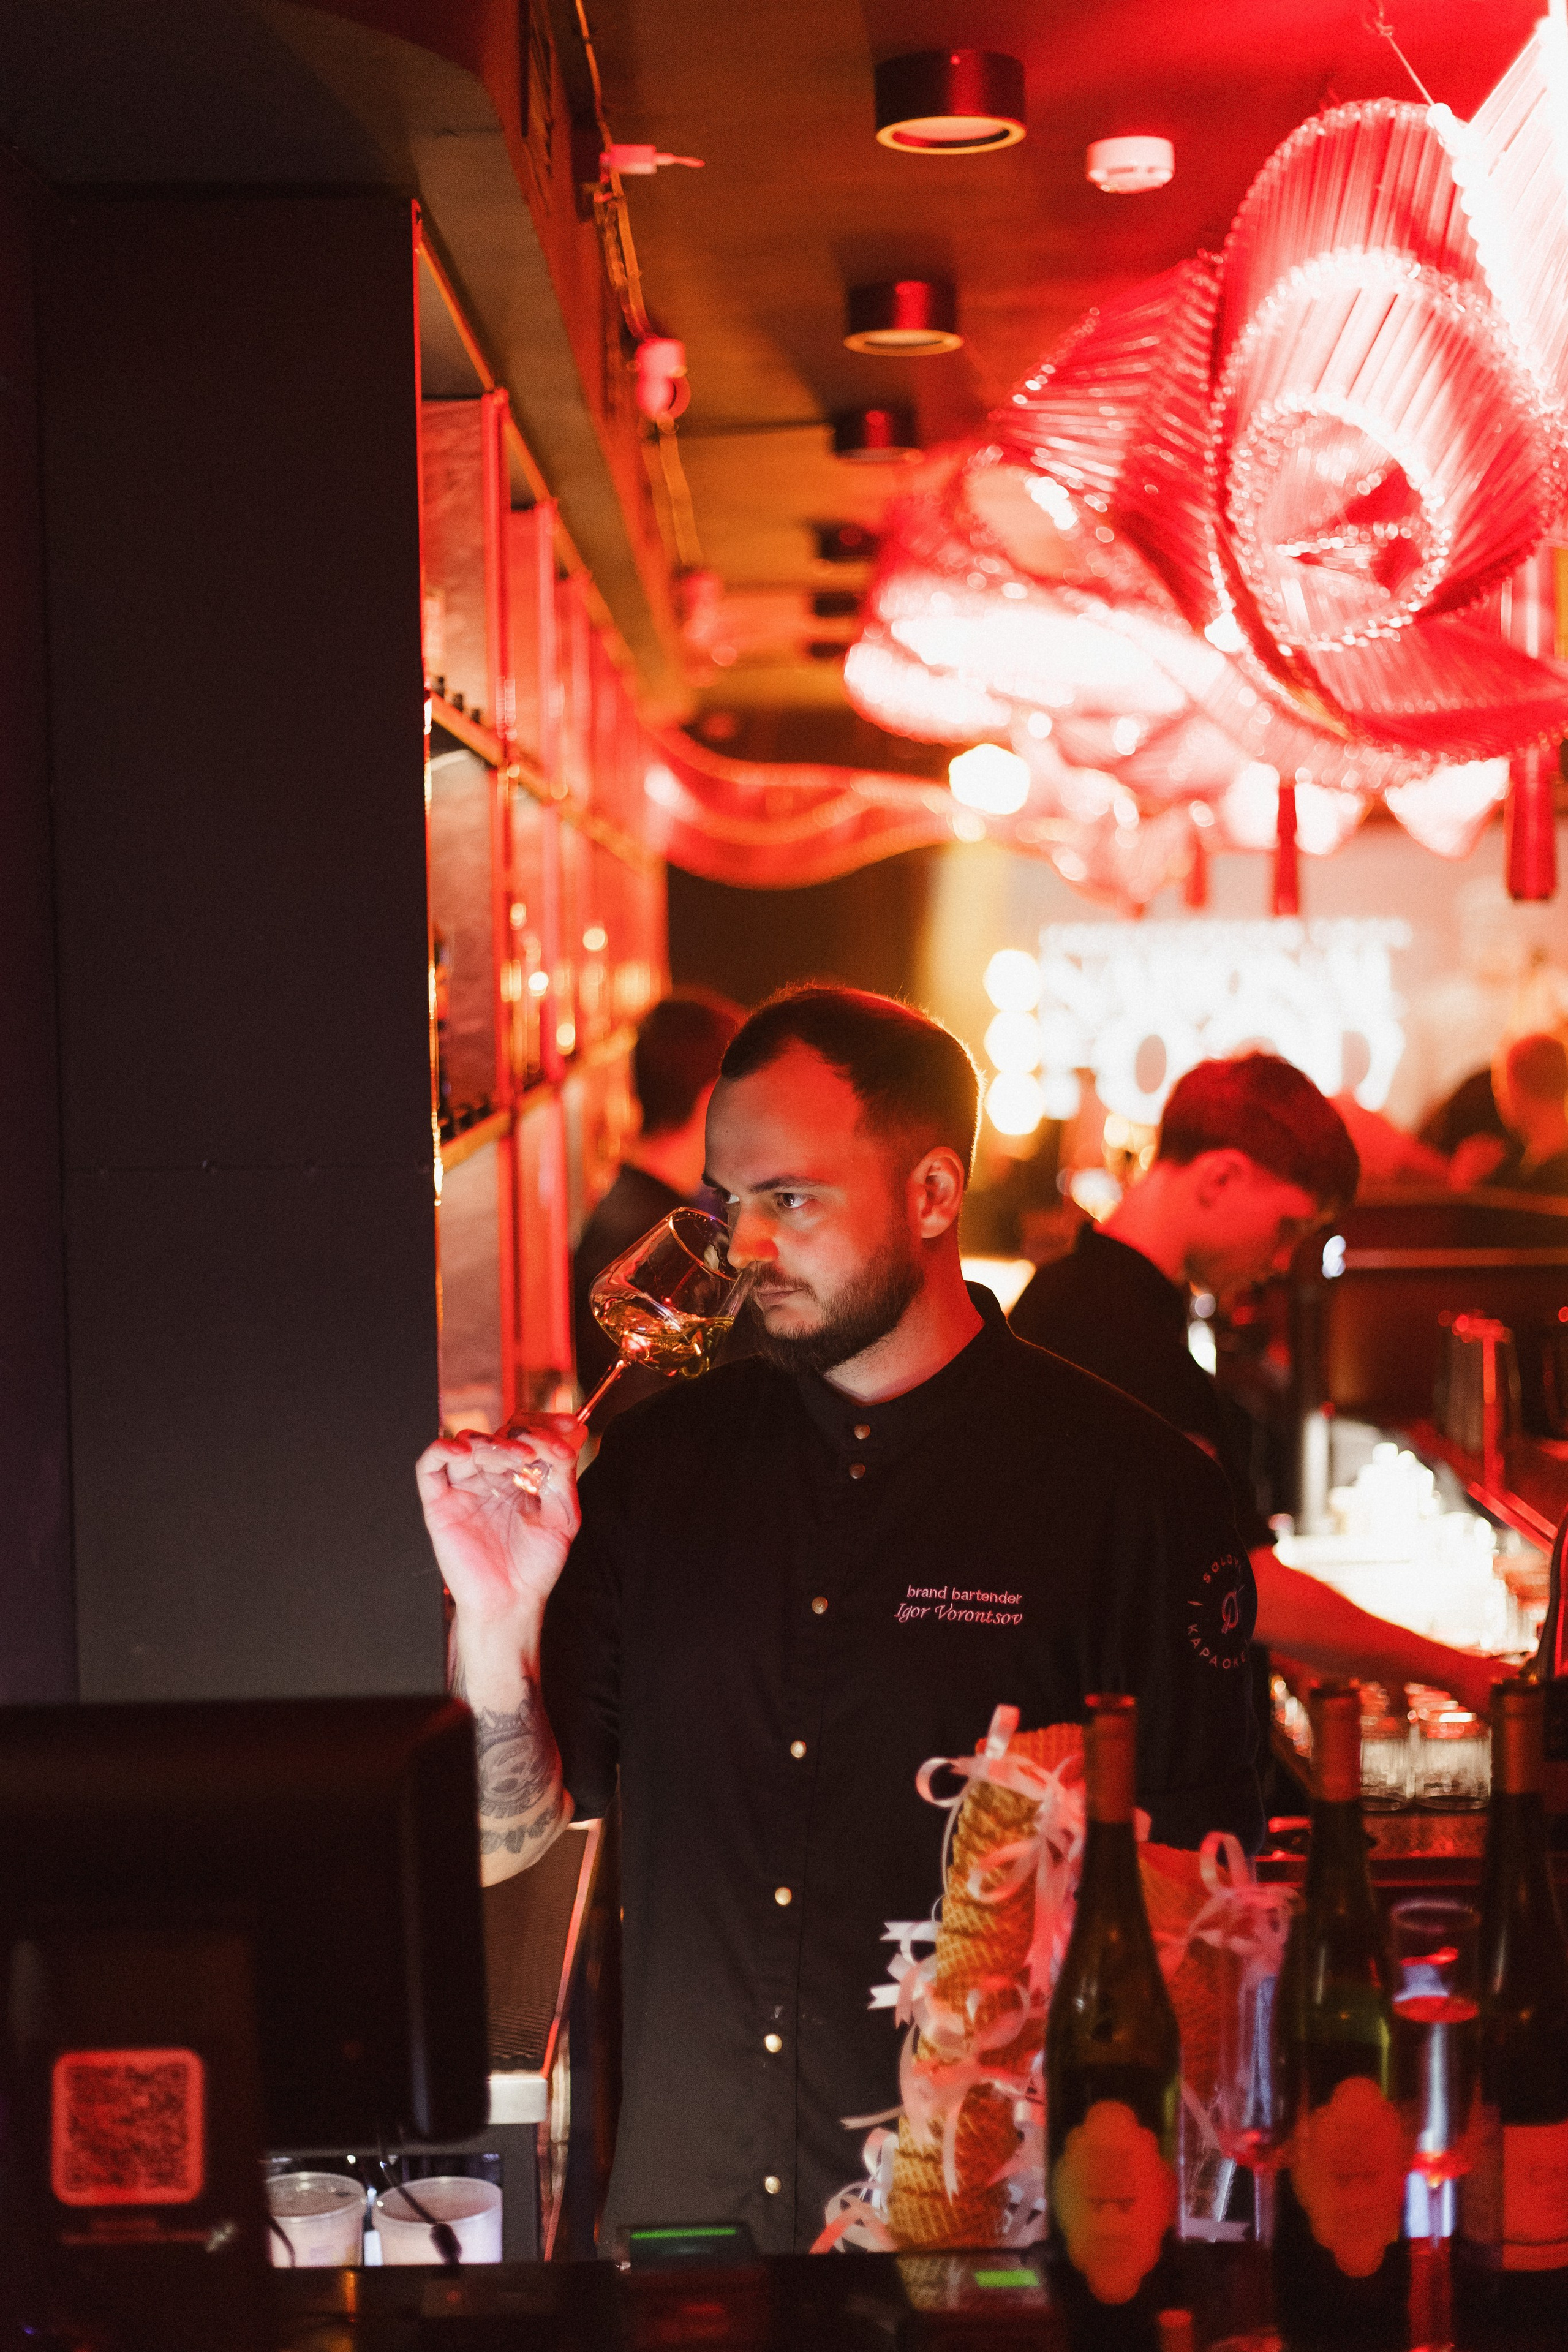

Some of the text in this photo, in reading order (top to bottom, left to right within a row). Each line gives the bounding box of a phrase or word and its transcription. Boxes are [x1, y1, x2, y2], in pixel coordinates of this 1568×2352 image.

[907, 1585, 1022, 1604] brand bartender
[894, 1602, 1022, 1625] Igor Vorontsov
